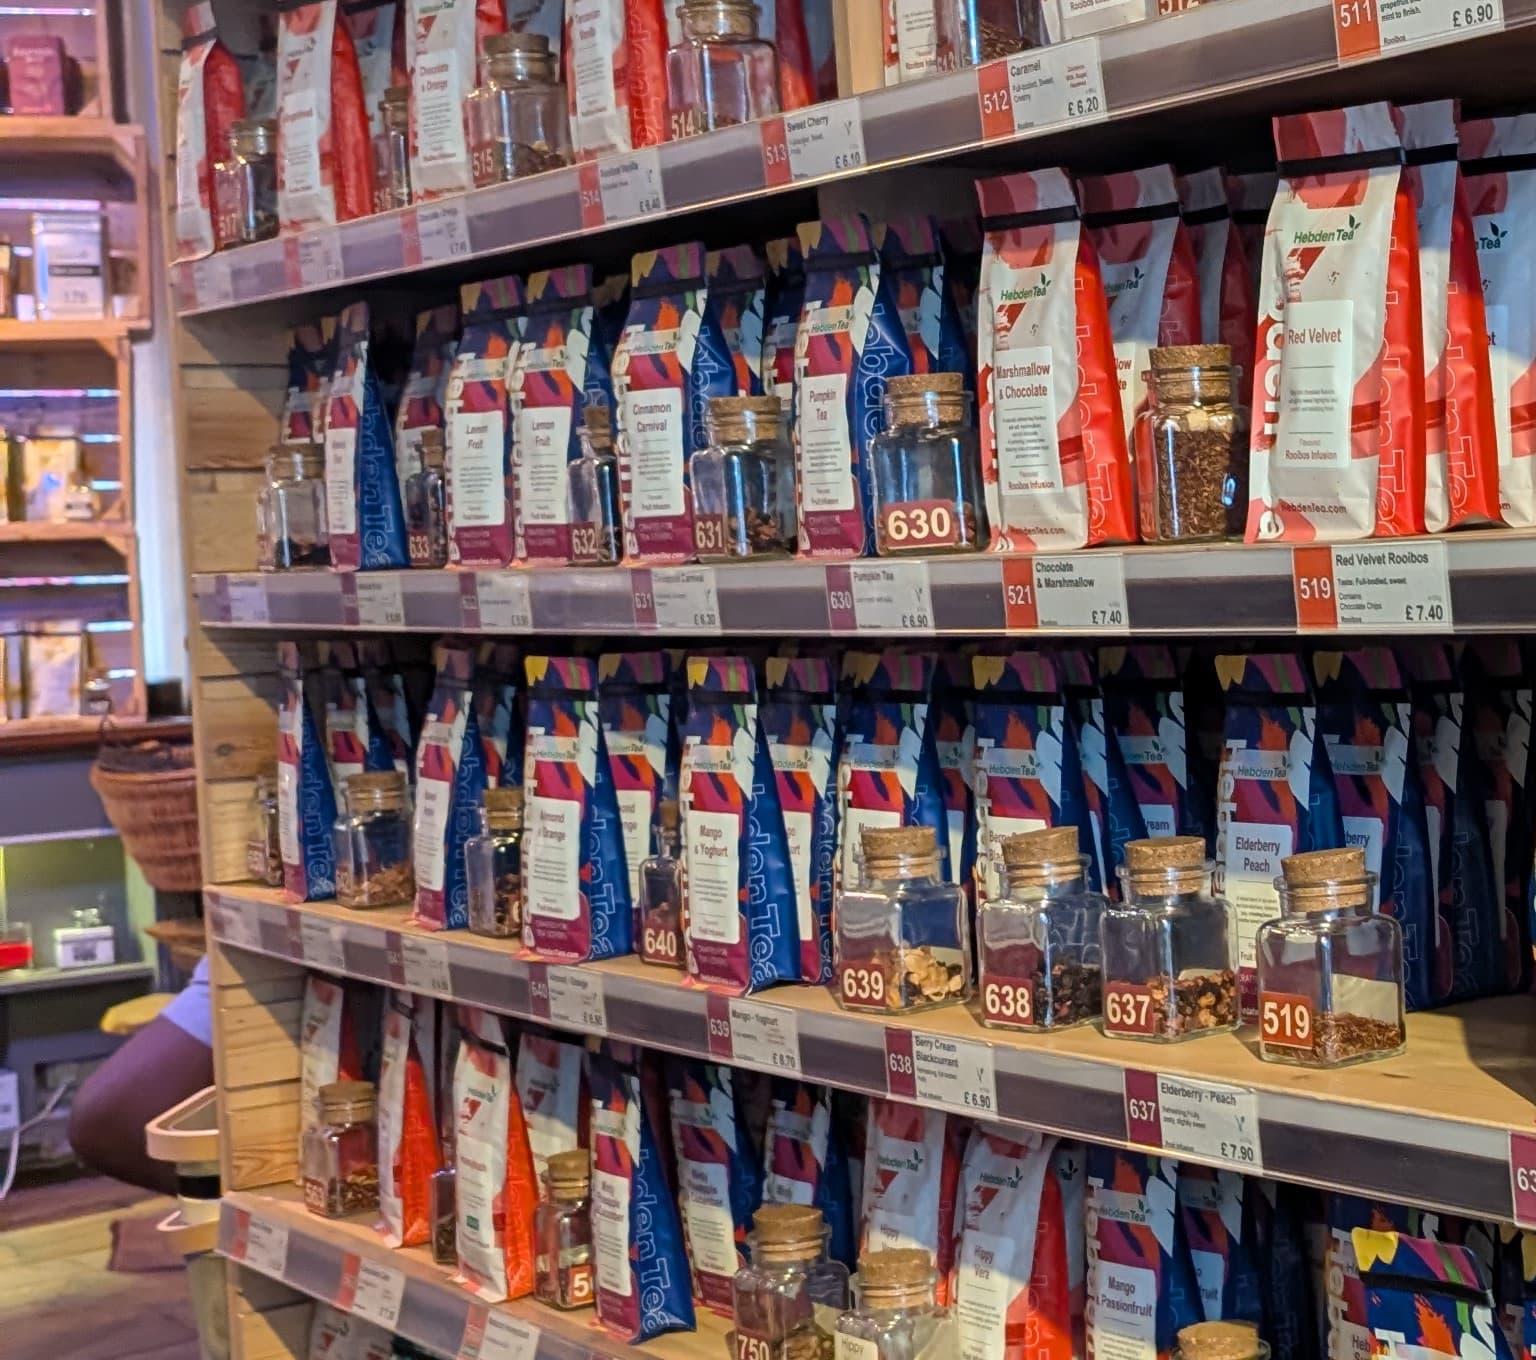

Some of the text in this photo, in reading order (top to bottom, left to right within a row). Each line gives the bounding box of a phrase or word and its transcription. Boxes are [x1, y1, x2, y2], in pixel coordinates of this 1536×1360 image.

[1339, 1, 1373, 28] 511
[1452, 3, 1493, 26] £ 6.90
[887, 507, 950, 540] 630
[1035, 560, 1074, 574] Chocolate
[1335, 551, 1428, 567] Red Velvet Rooibos
[1007, 584, 1032, 605] 521
[1300, 576, 1331, 601] 519
[843, 969, 884, 1000] 639
[985, 984, 1030, 1016] 638
[1106, 991, 1150, 1024] 637
[1263, 1002, 1308, 1040] 519
[1129, 1098, 1156, 1122] 637
